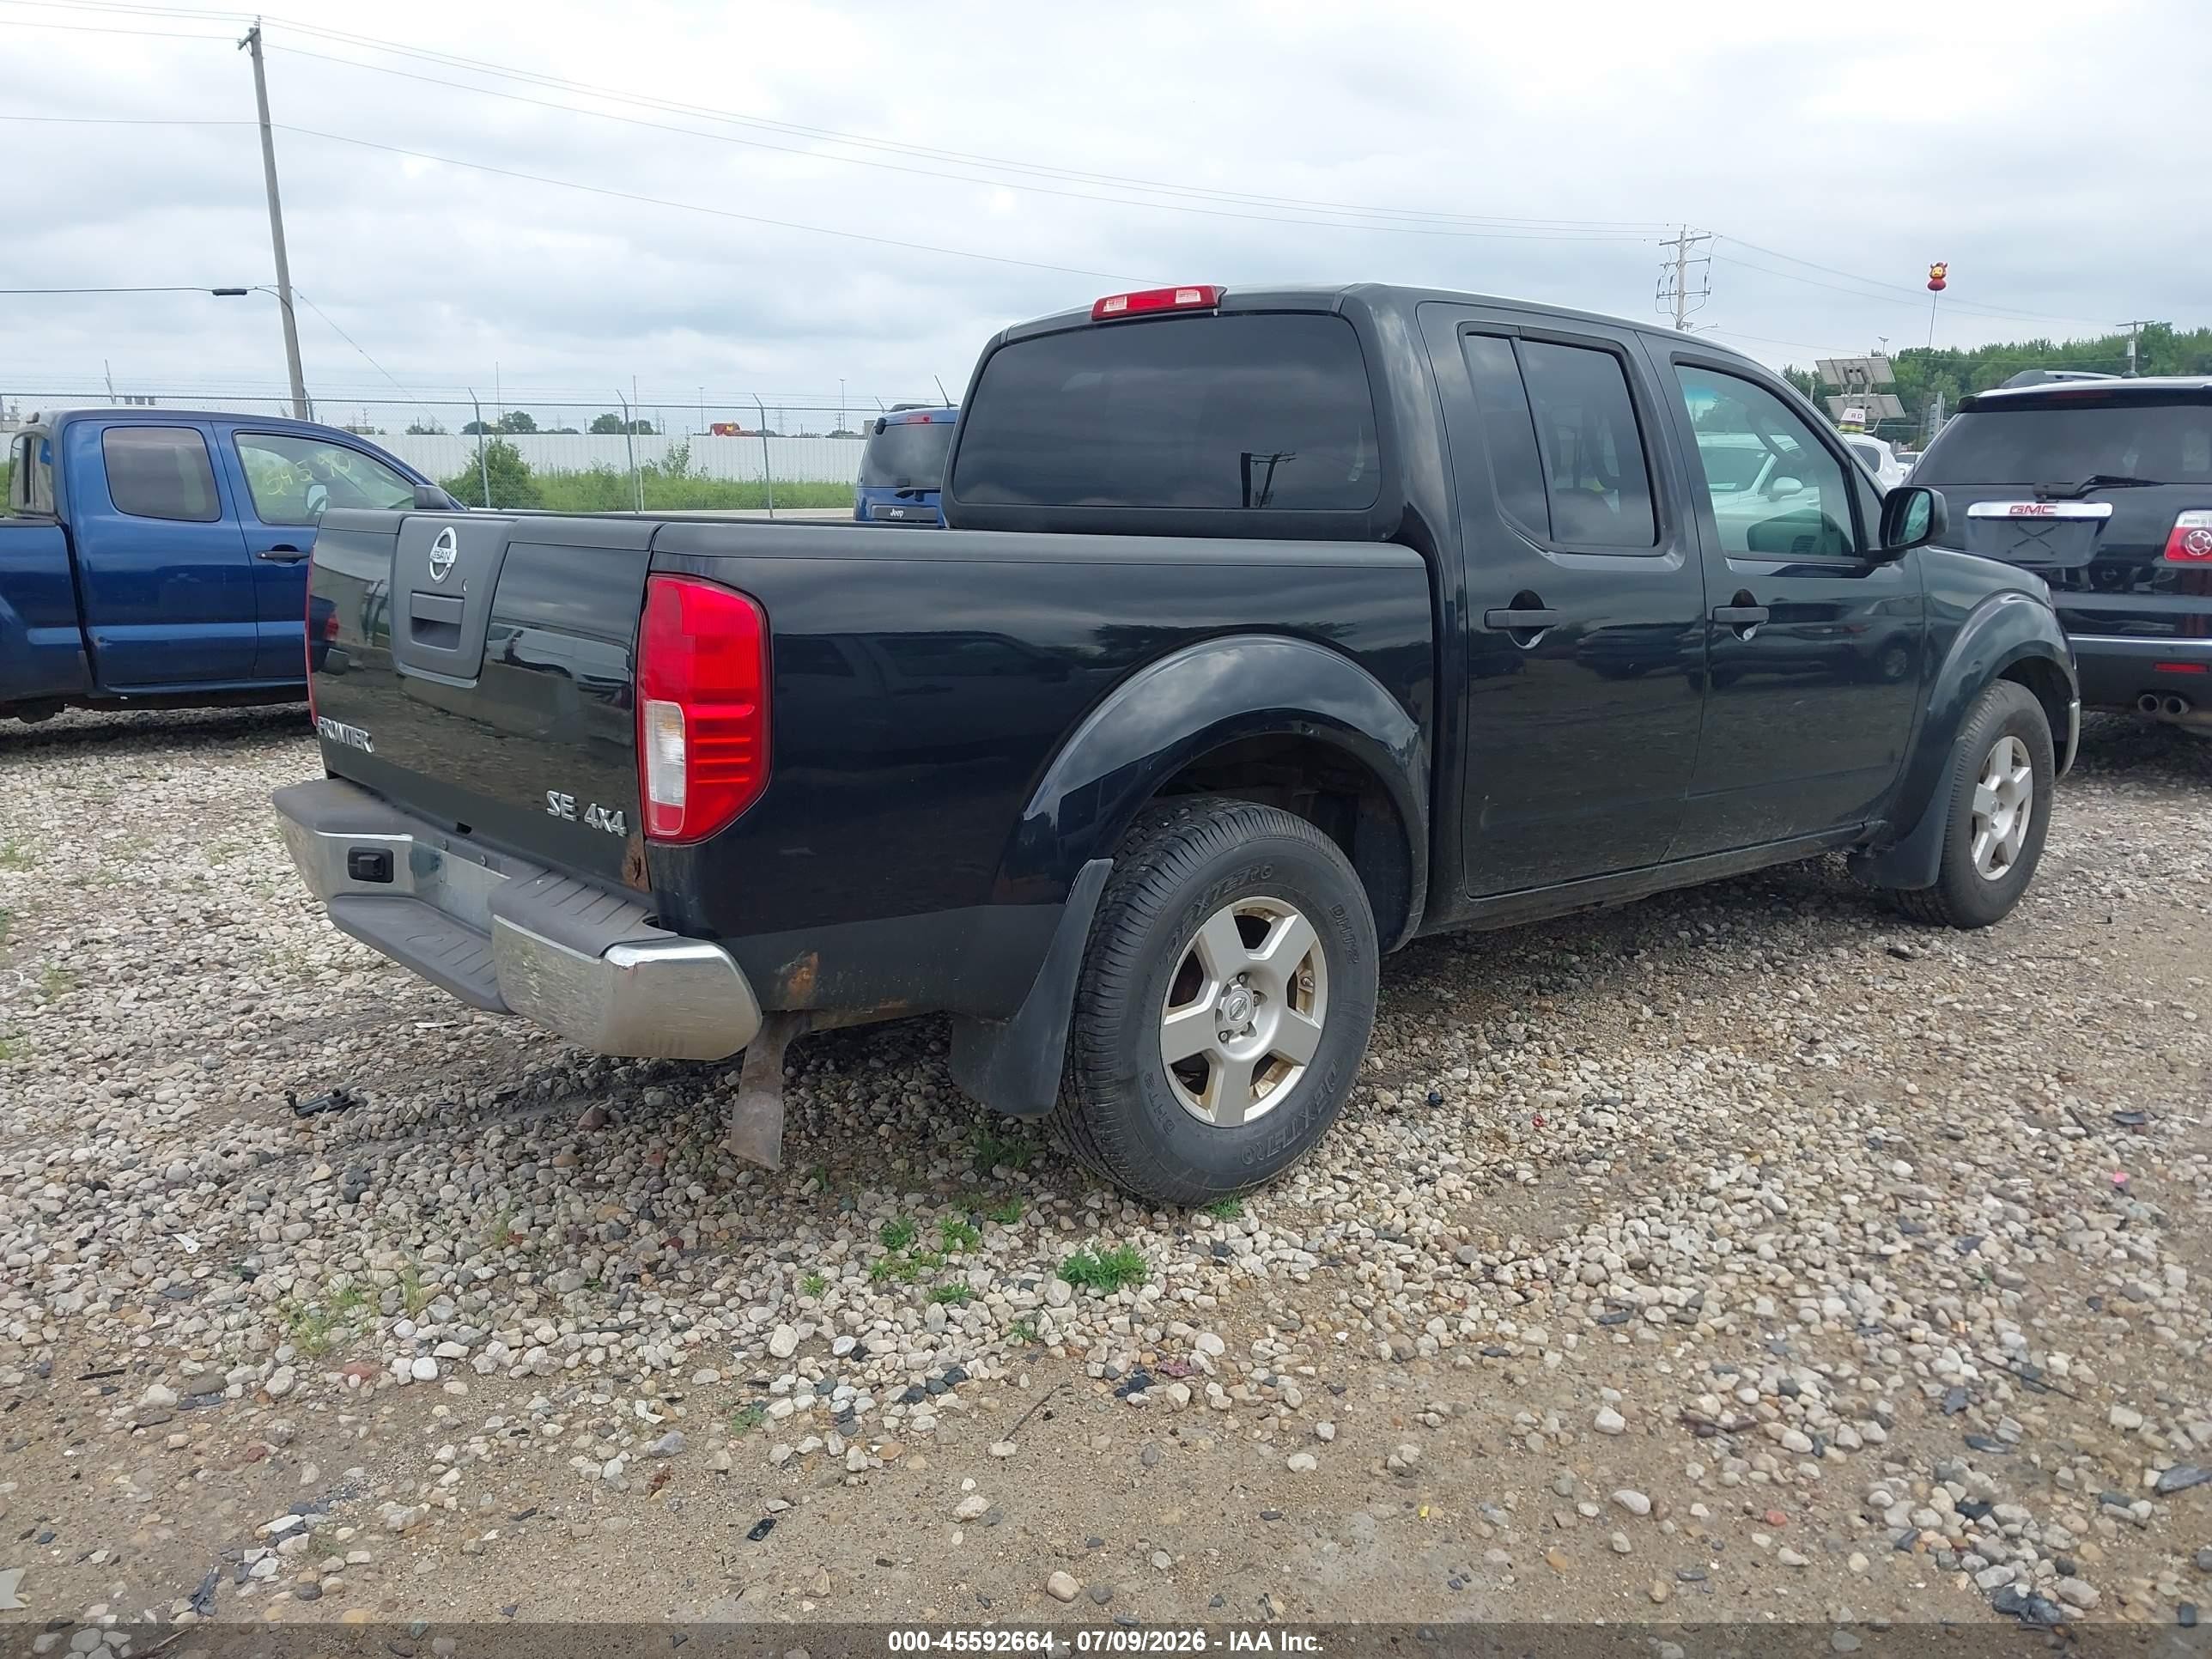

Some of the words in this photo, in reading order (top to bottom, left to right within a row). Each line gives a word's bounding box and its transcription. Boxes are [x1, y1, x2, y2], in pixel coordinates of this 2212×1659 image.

[2008, 505, 2058, 515] GMC
[317, 715, 375, 753] FRONTIER
[546, 790, 577, 822] SE
[1329, 902, 1361, 966] DHT2
